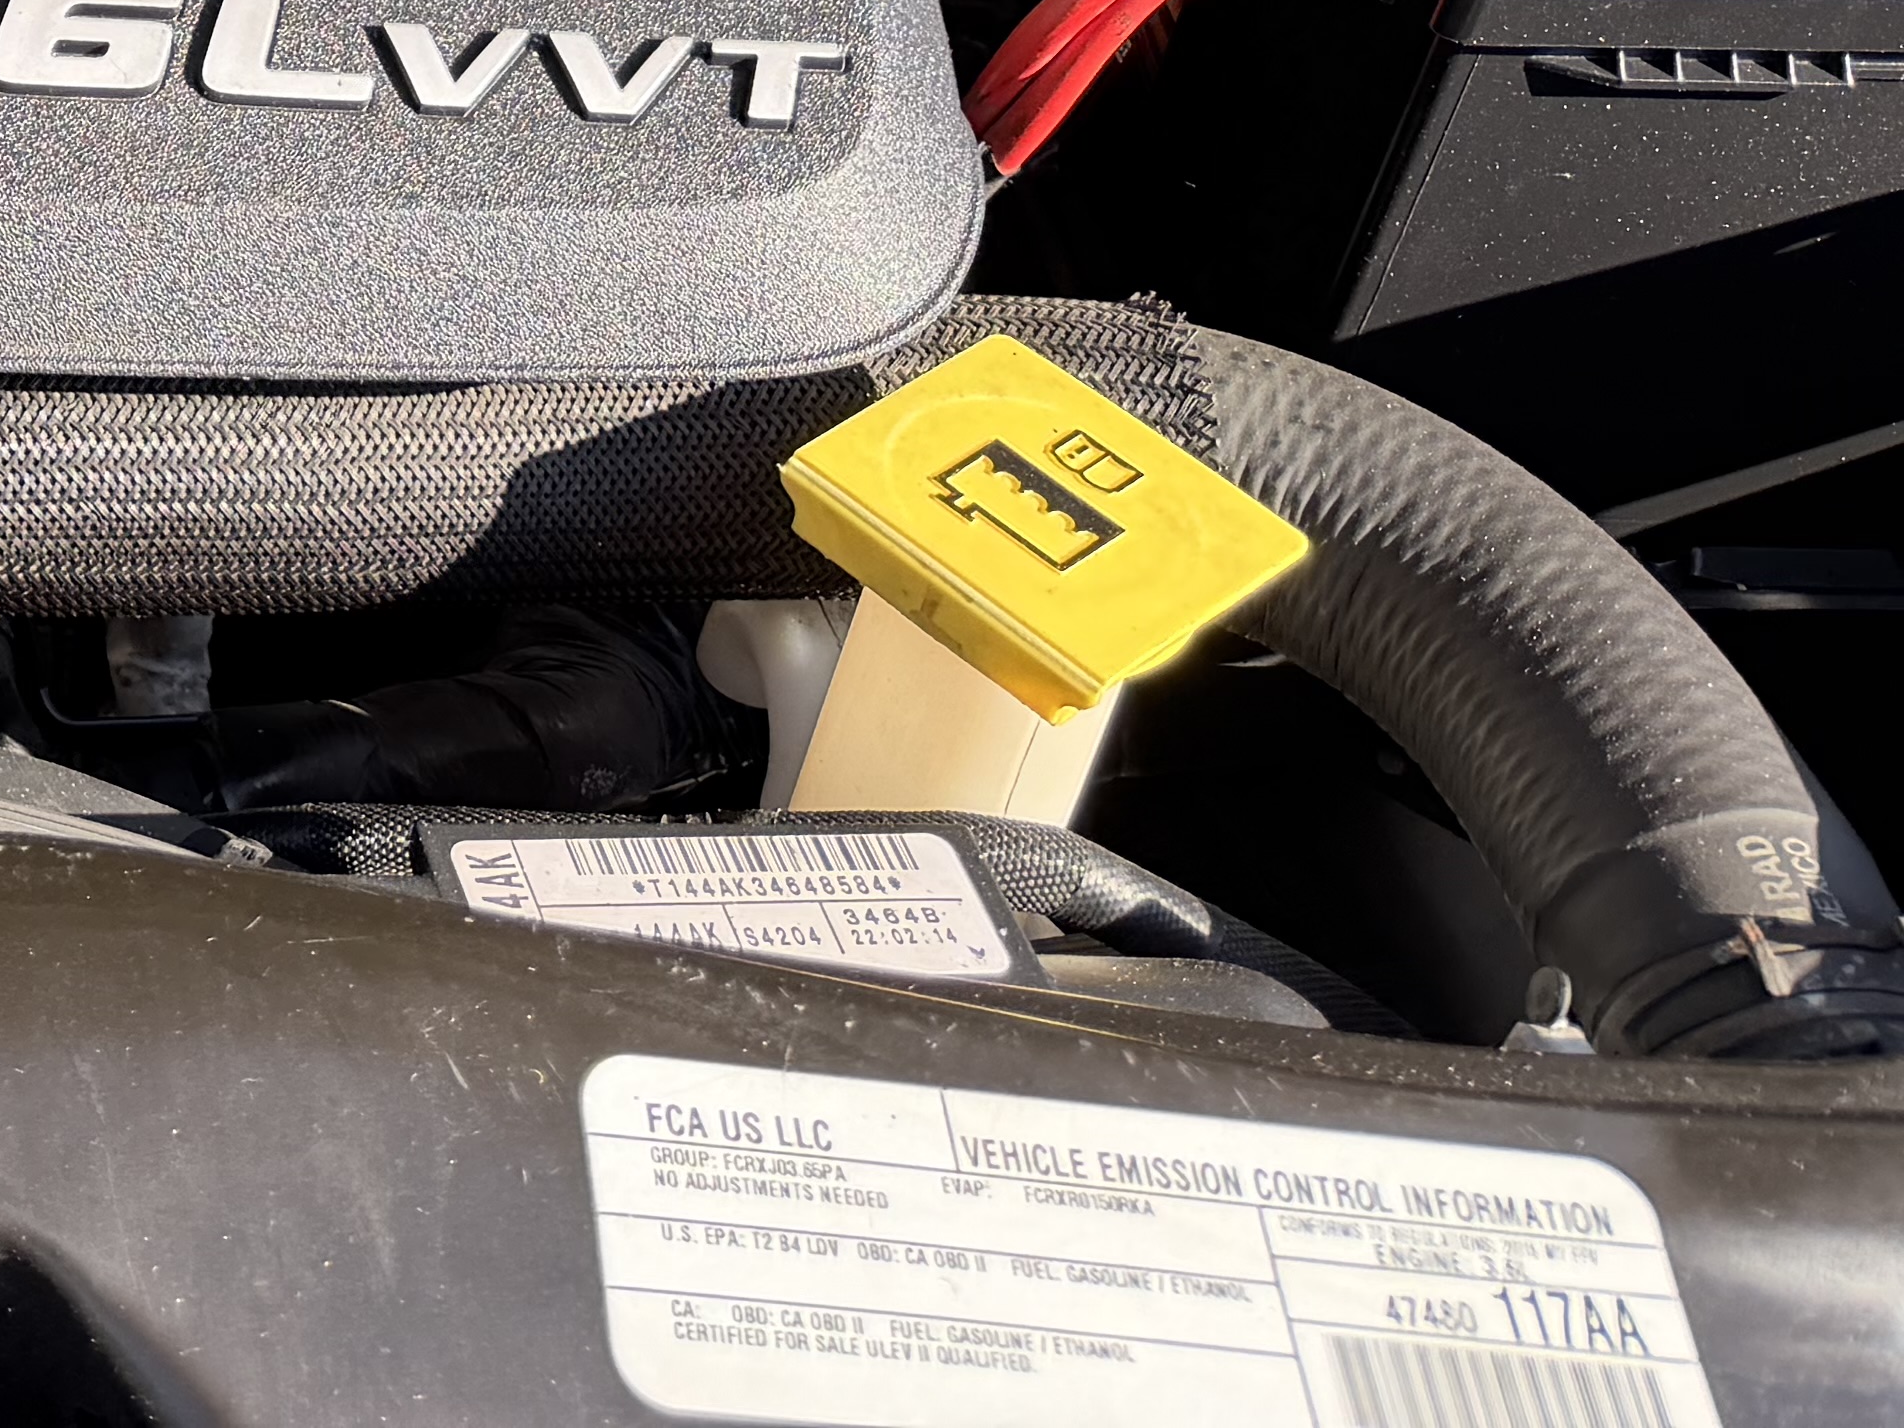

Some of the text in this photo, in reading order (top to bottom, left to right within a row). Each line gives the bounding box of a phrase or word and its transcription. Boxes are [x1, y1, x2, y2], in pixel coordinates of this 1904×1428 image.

[1735, 834, 1802, 902] RAD
[743, 925, 822, 948] S4204
[644, 1101, 834, 1153] FCA US LLC
[649, 1145, 719, 1171] GROUP:
[652, 1168, 891, 1211] NO ADJUSTMENTS NEEDED
[959, 1134, 1616, 1238] VEHICLE EMISSION CONTROL INFORMATION
[660, 1222, 699, 1245] U.S.
[703, 1225, 747, 1249] EPA:
[750, 1229, 775, 1252] T2
[806, 1235, 841, 1258] LDV
[904, 1245, 930, 1267] CA
[933, 1249, 970, 1271] OBD
[1066, 1263, 1154, 1293] GASOLINE
[1169, 1274, 1255, 1304] ETHANOL
[672, 1320, 769, 1349] CERTIFIED
[773, 1329, 812, 1353] FOR
[814, 1333, 863, 1358] SALE
[865, 1338, 913, 1362] ULEV
[780, 1308, 805, 1330] CA
[809, 1312, 848, 1335] OBD
[946, 1324, 1036, 1354] GASOLINE
[1053, 1335, 1138, 1365] ETHANOL
[1490, 1284, 1655, 1360] 117AA
